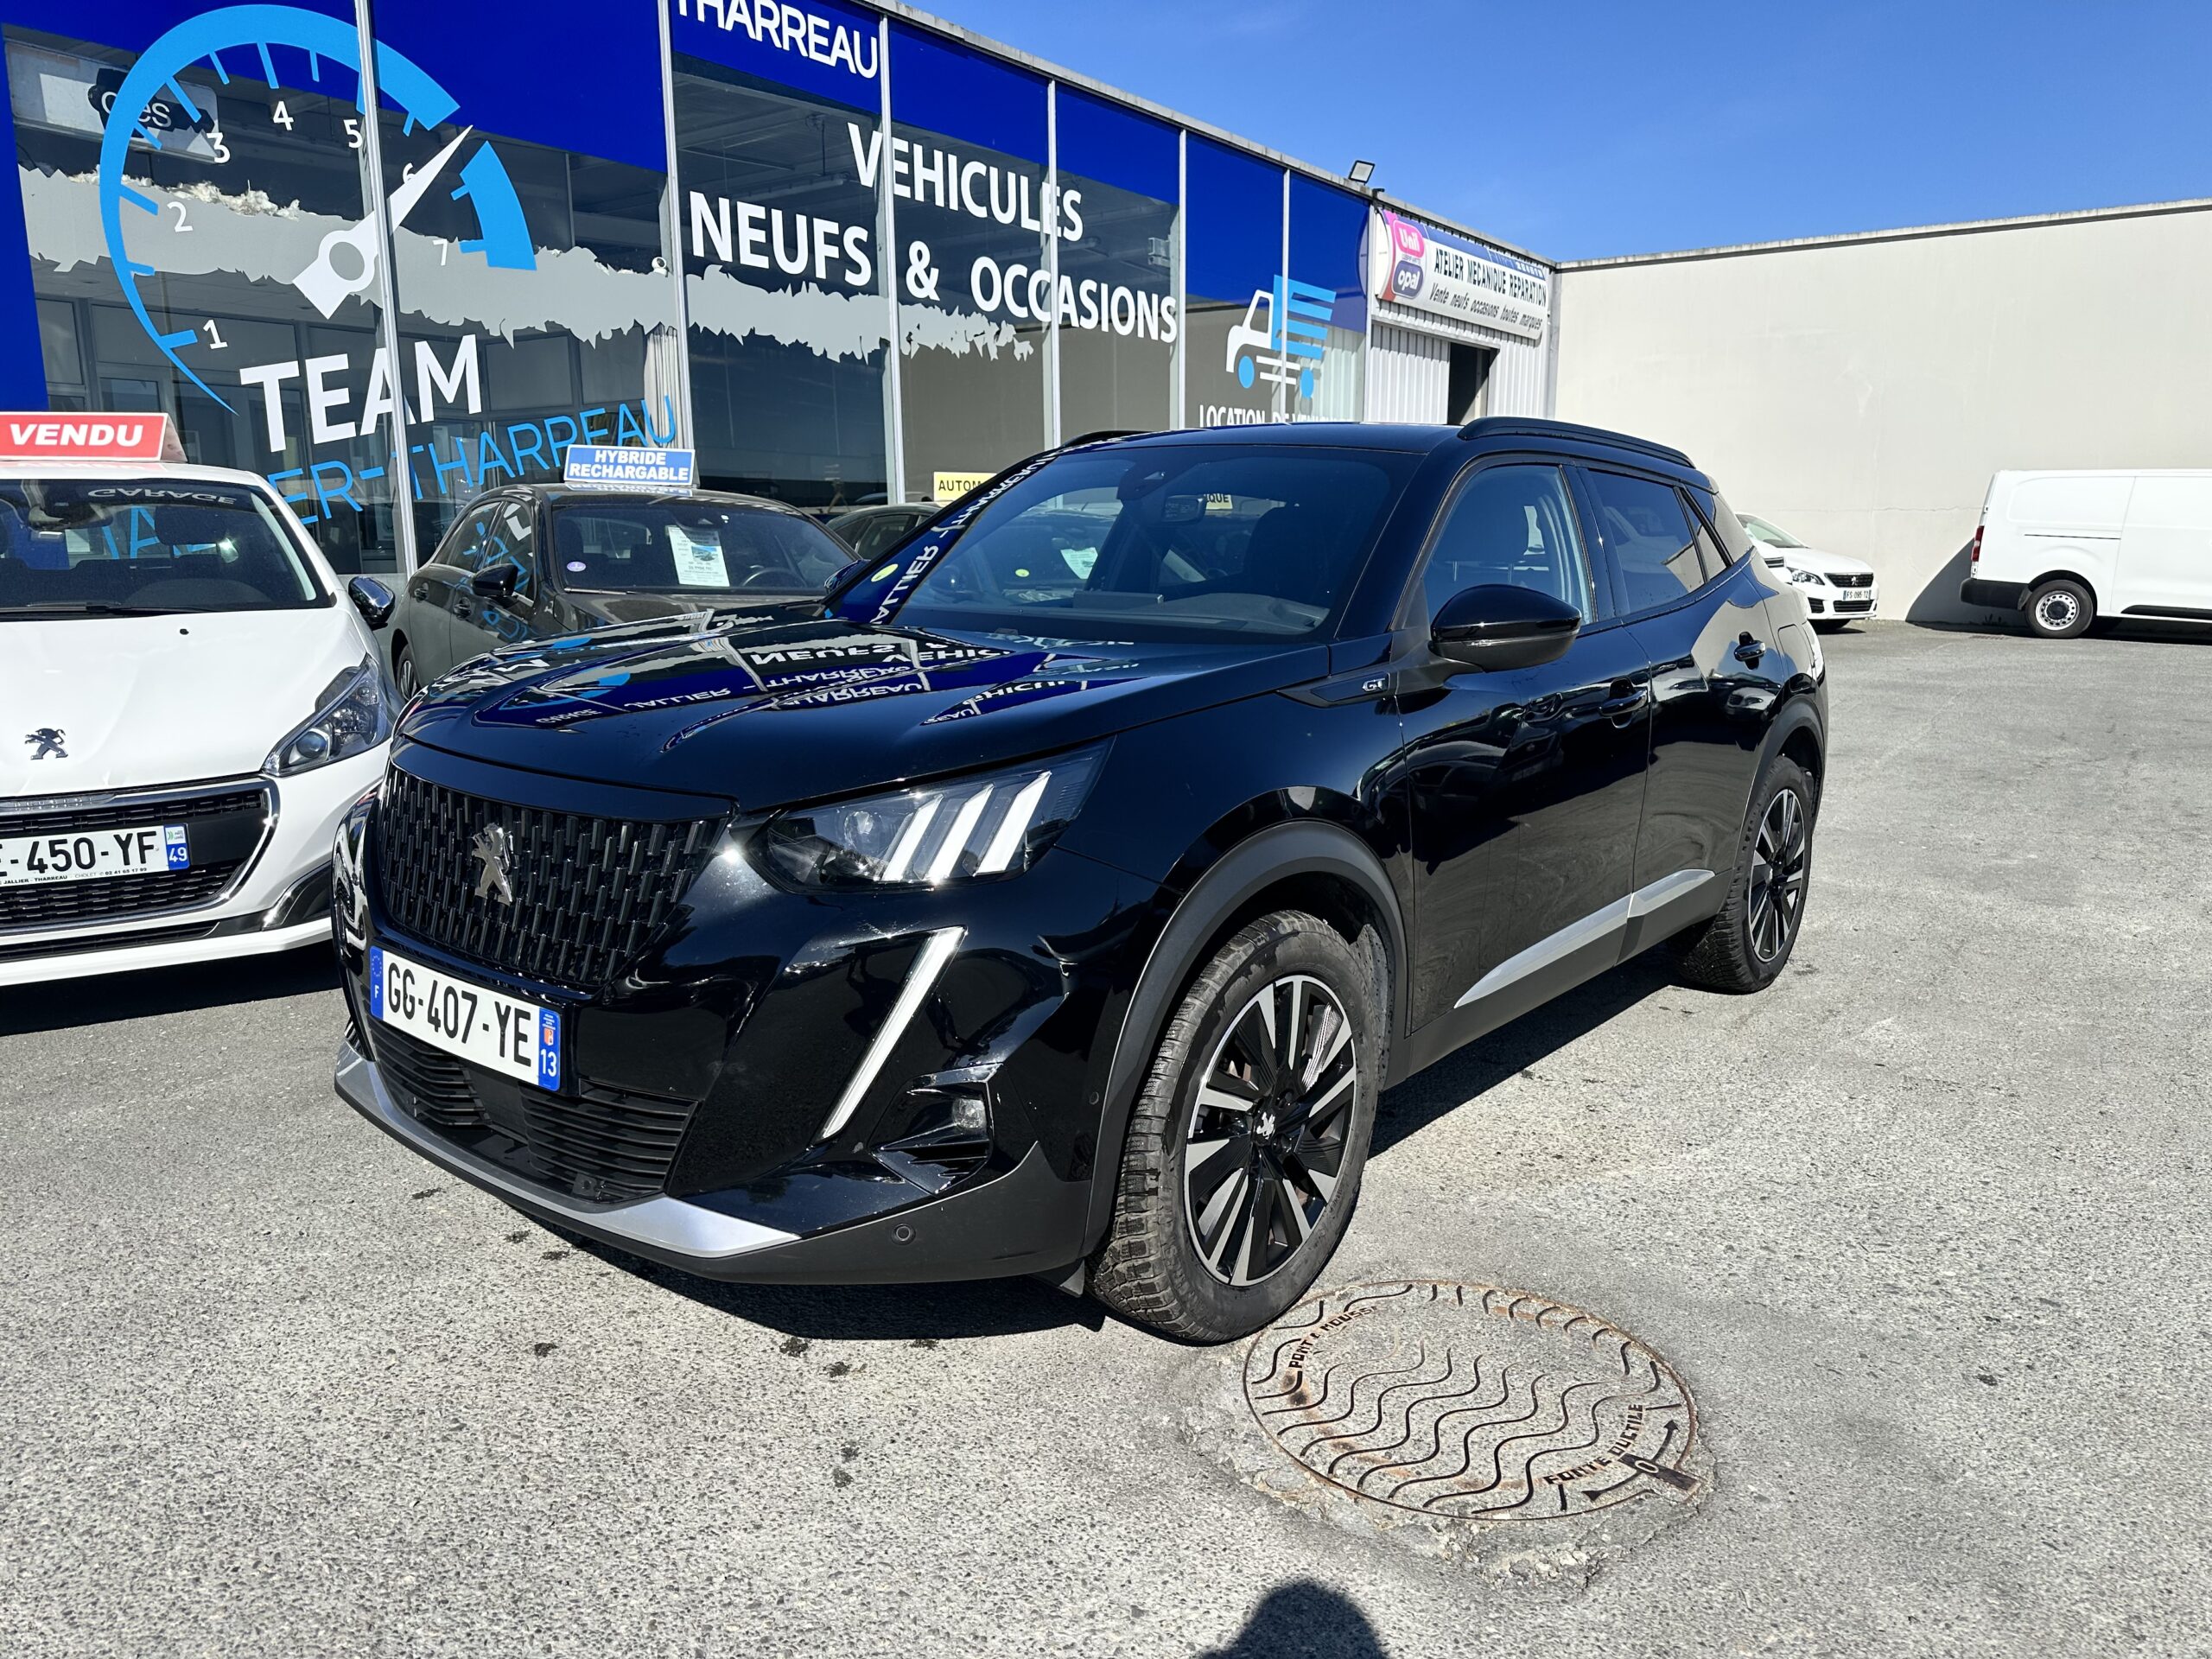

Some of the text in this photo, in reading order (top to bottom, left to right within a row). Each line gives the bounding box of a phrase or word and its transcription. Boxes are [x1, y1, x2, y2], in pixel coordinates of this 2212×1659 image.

[273, 101, 294, 130] 4
[207, 132, 230, 163] 3
[344, 119, 363, 149] 5
[848, 122, 1084, 242] VEHICULES
[167, 201, 192, 232] 2
[432, 239, 449, 265] 7
[1399, 228, 1421, 251] Unil
[690, 190, 1178, 343] NEUFS & OCCASIONS
[1397, 270, 1421, 291] opal
[1434, 247, 1464, 282] ATELIER
[1467, 260, 1506, 295] MECANIQUE
[1510, 275, 1547, 308] REPARATION
[1429, 283, 1449, 303] Vente
[1451, 291, 1469, 311] neufs
[1471, 299, 1500, 320] occasions
[1501, 304, 1520, 324] toutes
[203, 320, 227, 349] 1
[239, 334, 482, 453] TEAM
[1199, 404, 1266, 429] LOCATION
[9, 423, 144, 448] VENDU
[569, 463, 689, 481] RECHARGABLE
[594, 450, 667, 466] HYBRIDE
[168, 846, 188, 863] 49
[373, 984, 380, 999] F
[387, 962, 532, 1068] GG-407-YE
[539, 1048, 557, 1078] 13
[1288, 1339, 1313, 1368] PONT
[1543, 1403, 1643, 1484] FONTE DUCTILE
